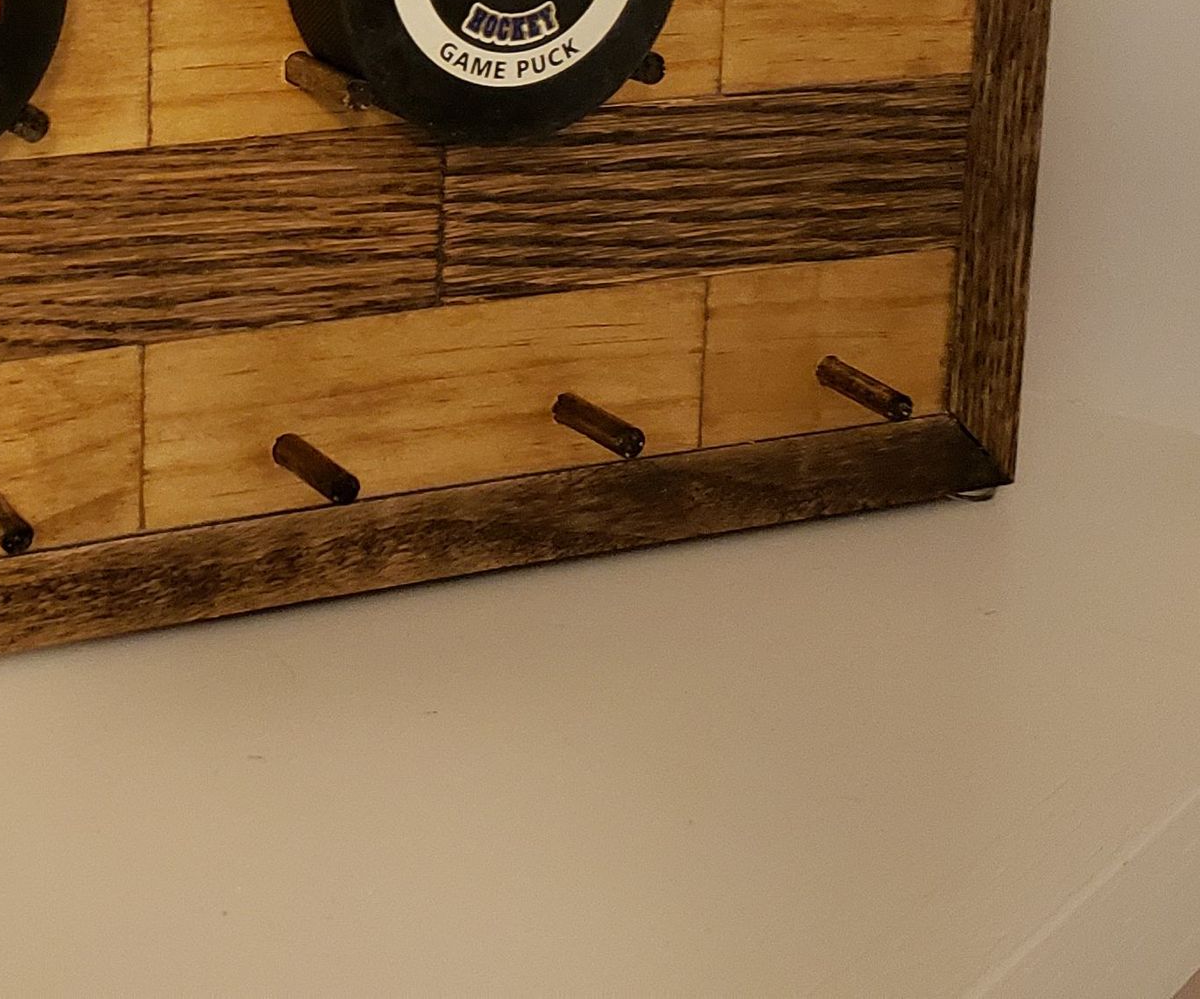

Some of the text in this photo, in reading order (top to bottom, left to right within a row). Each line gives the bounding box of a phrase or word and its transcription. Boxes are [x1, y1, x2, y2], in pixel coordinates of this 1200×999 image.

[461, 1, 560, 46] HOCKEY
[439, 37, 581, 79] GAME PUCK
